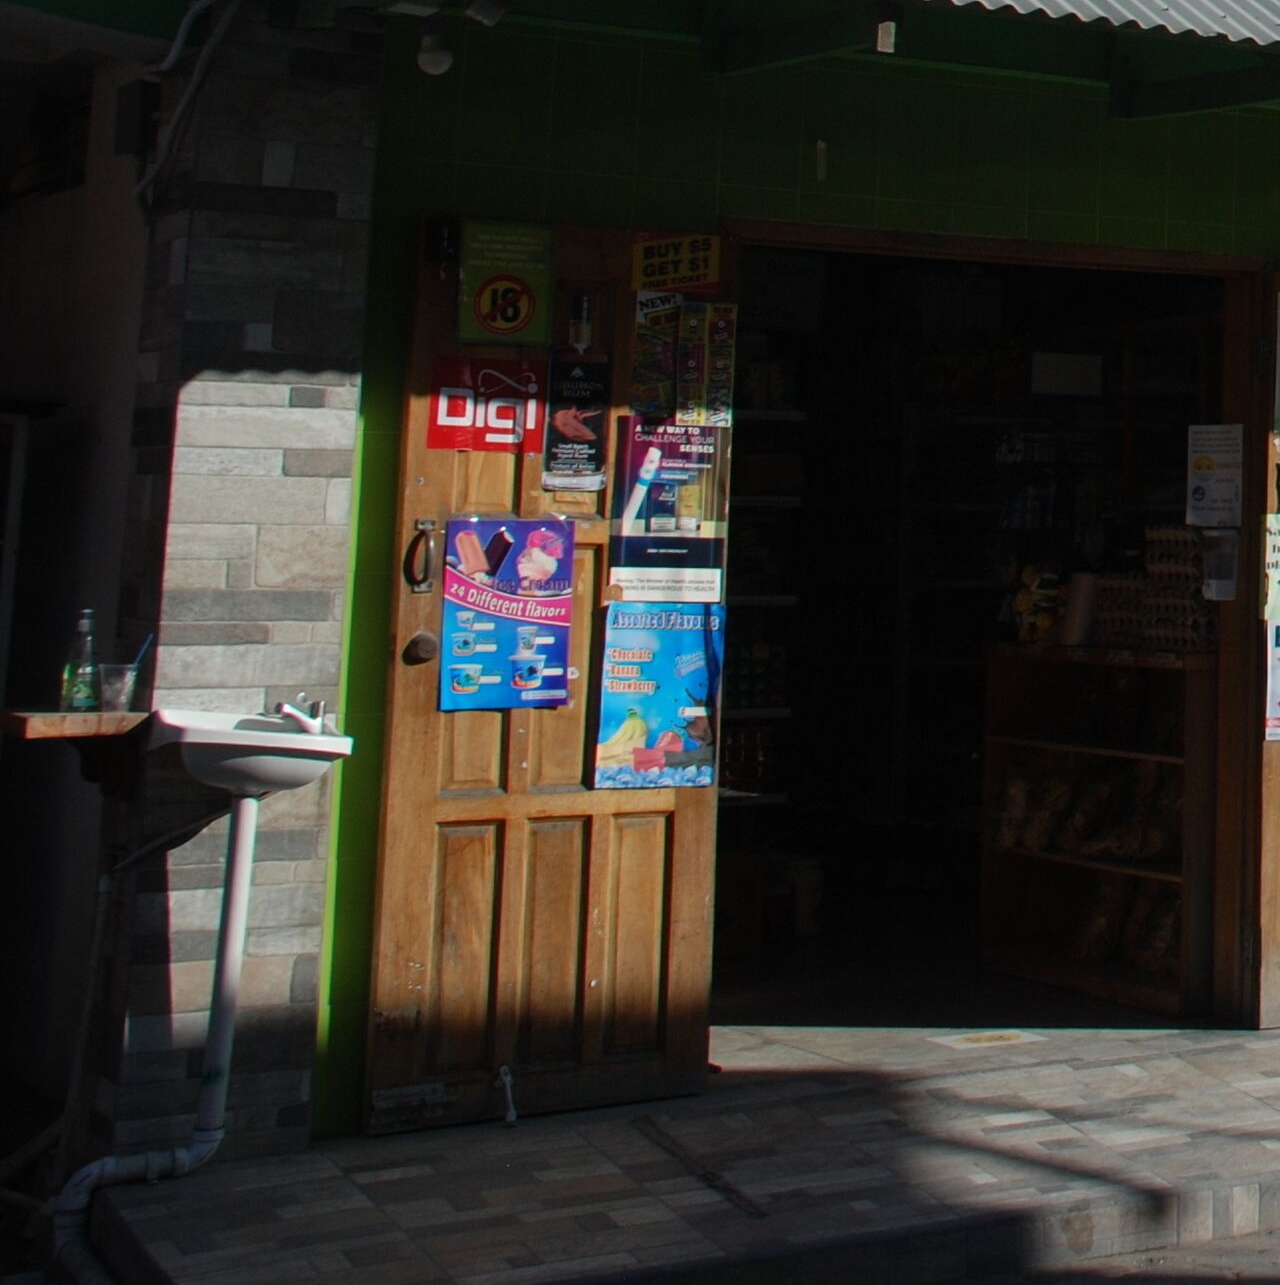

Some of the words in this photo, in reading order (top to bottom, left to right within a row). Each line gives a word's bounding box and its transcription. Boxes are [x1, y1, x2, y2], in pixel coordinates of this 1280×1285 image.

[644, 241, 683, 261] BUY
[689, 238, 712, 255] $5
[643, 260, 683, 278] GET
[689, 256, 709, 274] $1
[670, 273, 709, 287] TICKET
[490, 287, 521, 323] 18
[639, 294, 678, 312] NEW!
[437, 387, 537, 444] Digi
[635, 424, 643, 432] A
[666, 426, 687, 435] WAY
[688, 427, 700, 435] TO
[635, 433, 688, 444] CHALLENGE
[690, 435, 714, 445] YOUR
[680, 444, 714, 453] SENSES
[517, 576, 570, 593] Cream
[449, 582, 466, 596] 24
[467, 588, 524, 616] Different
[526, 601, 566, 618] flavors
[613, 610, 665, 629] Assorted
